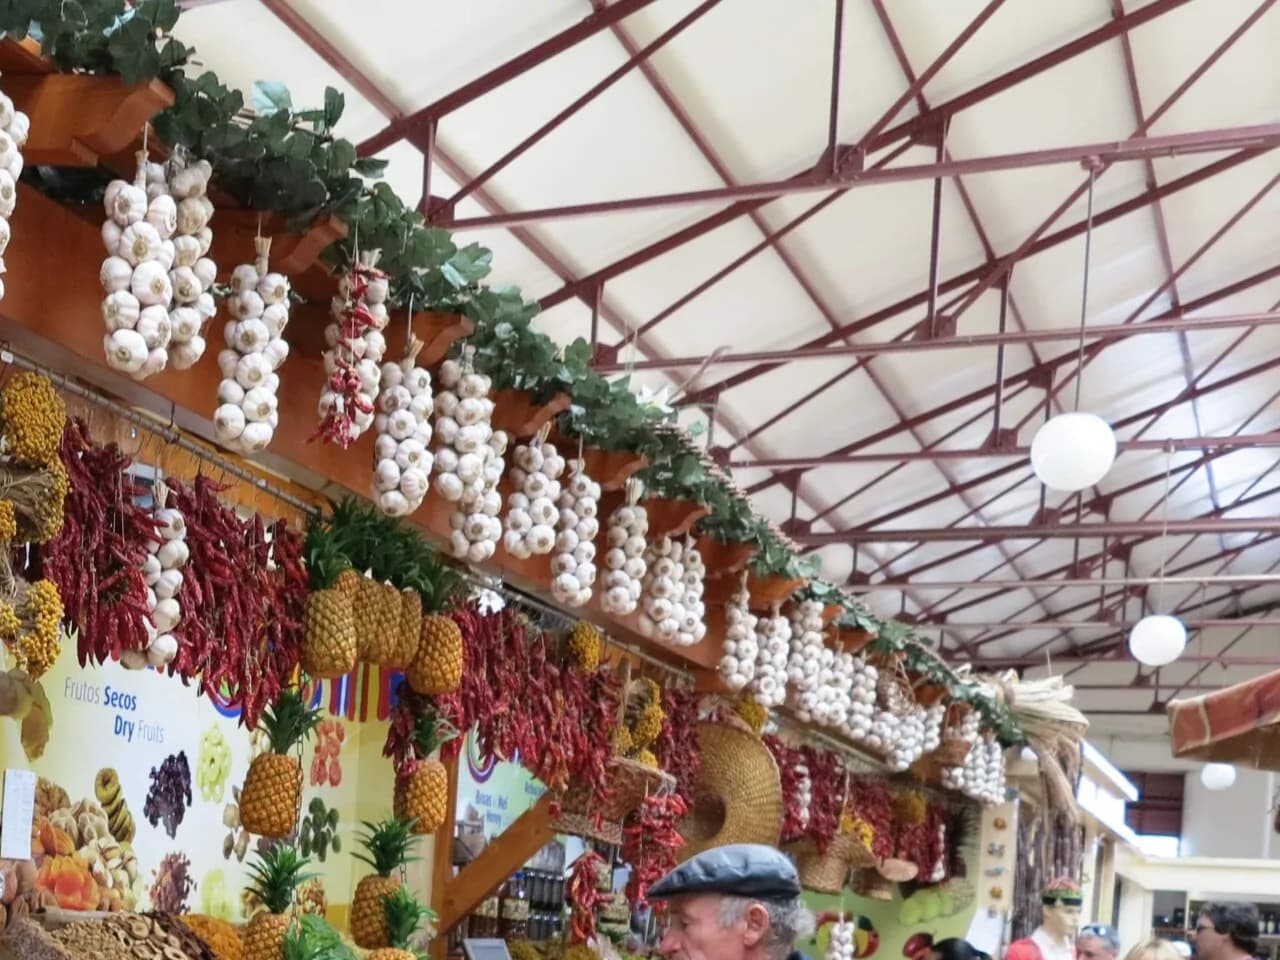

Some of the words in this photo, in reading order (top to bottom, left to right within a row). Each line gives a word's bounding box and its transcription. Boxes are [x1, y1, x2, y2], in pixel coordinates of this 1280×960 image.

[64, 676, 101, 705] Frutos
[103, 685, 137, 711] Secos
[114, 714, 135, 743] Dry
[138, 720, 164, 743] Fruits
